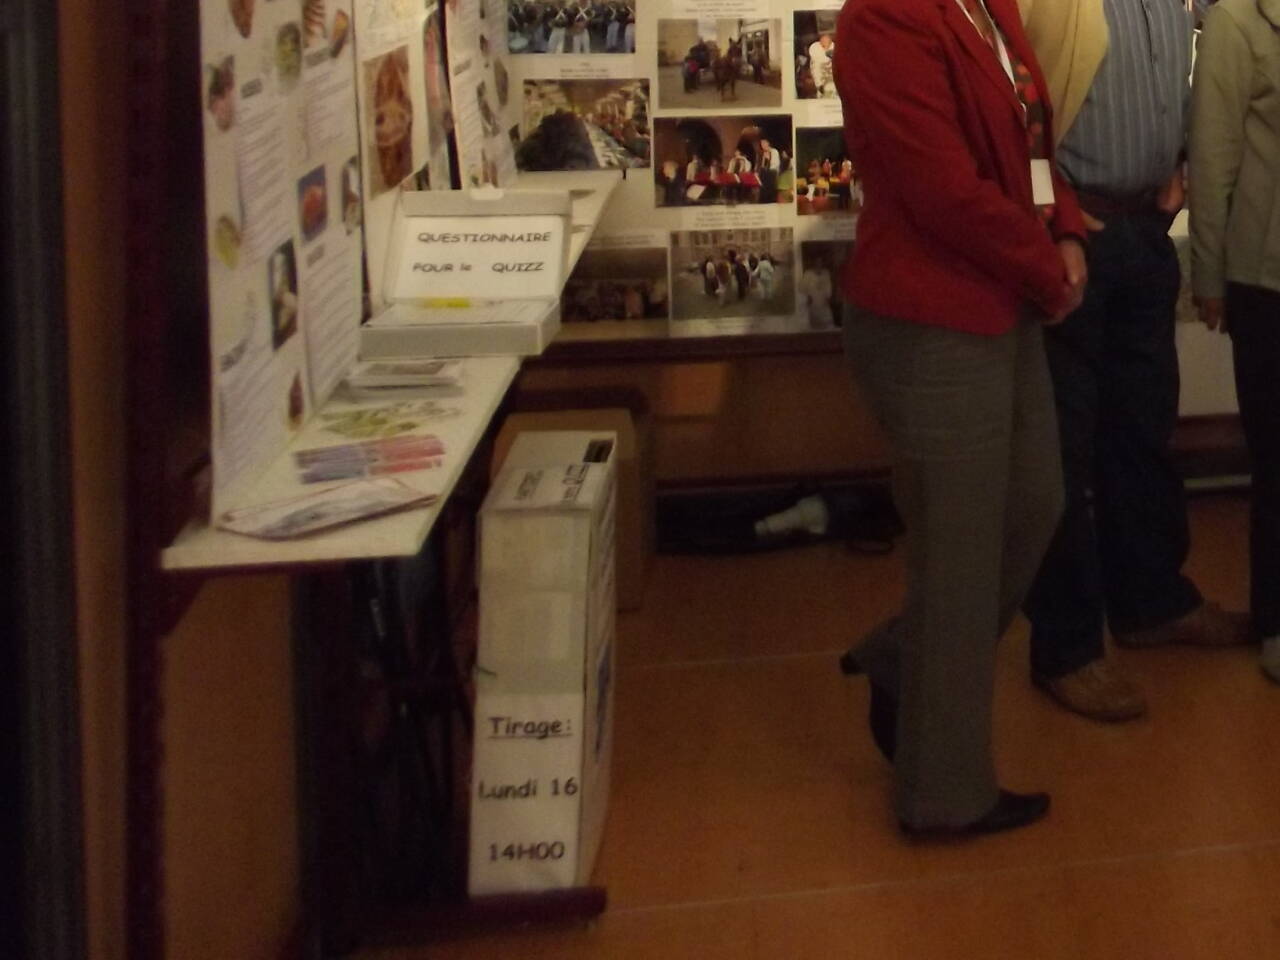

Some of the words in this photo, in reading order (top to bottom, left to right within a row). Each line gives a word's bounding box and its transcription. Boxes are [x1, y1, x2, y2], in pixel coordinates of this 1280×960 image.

[417, 231, 553, 244] QUESTIONNAIRE
[412, 262, 454, 273] POUR
[460, 262, 473, 272] le
[491, 262, 545, 273] QUIZZ
[478, 778, 537, 800] Lundi
[551, 776, 579, 797] 16
[488, 841, 566, 862] 14H00
